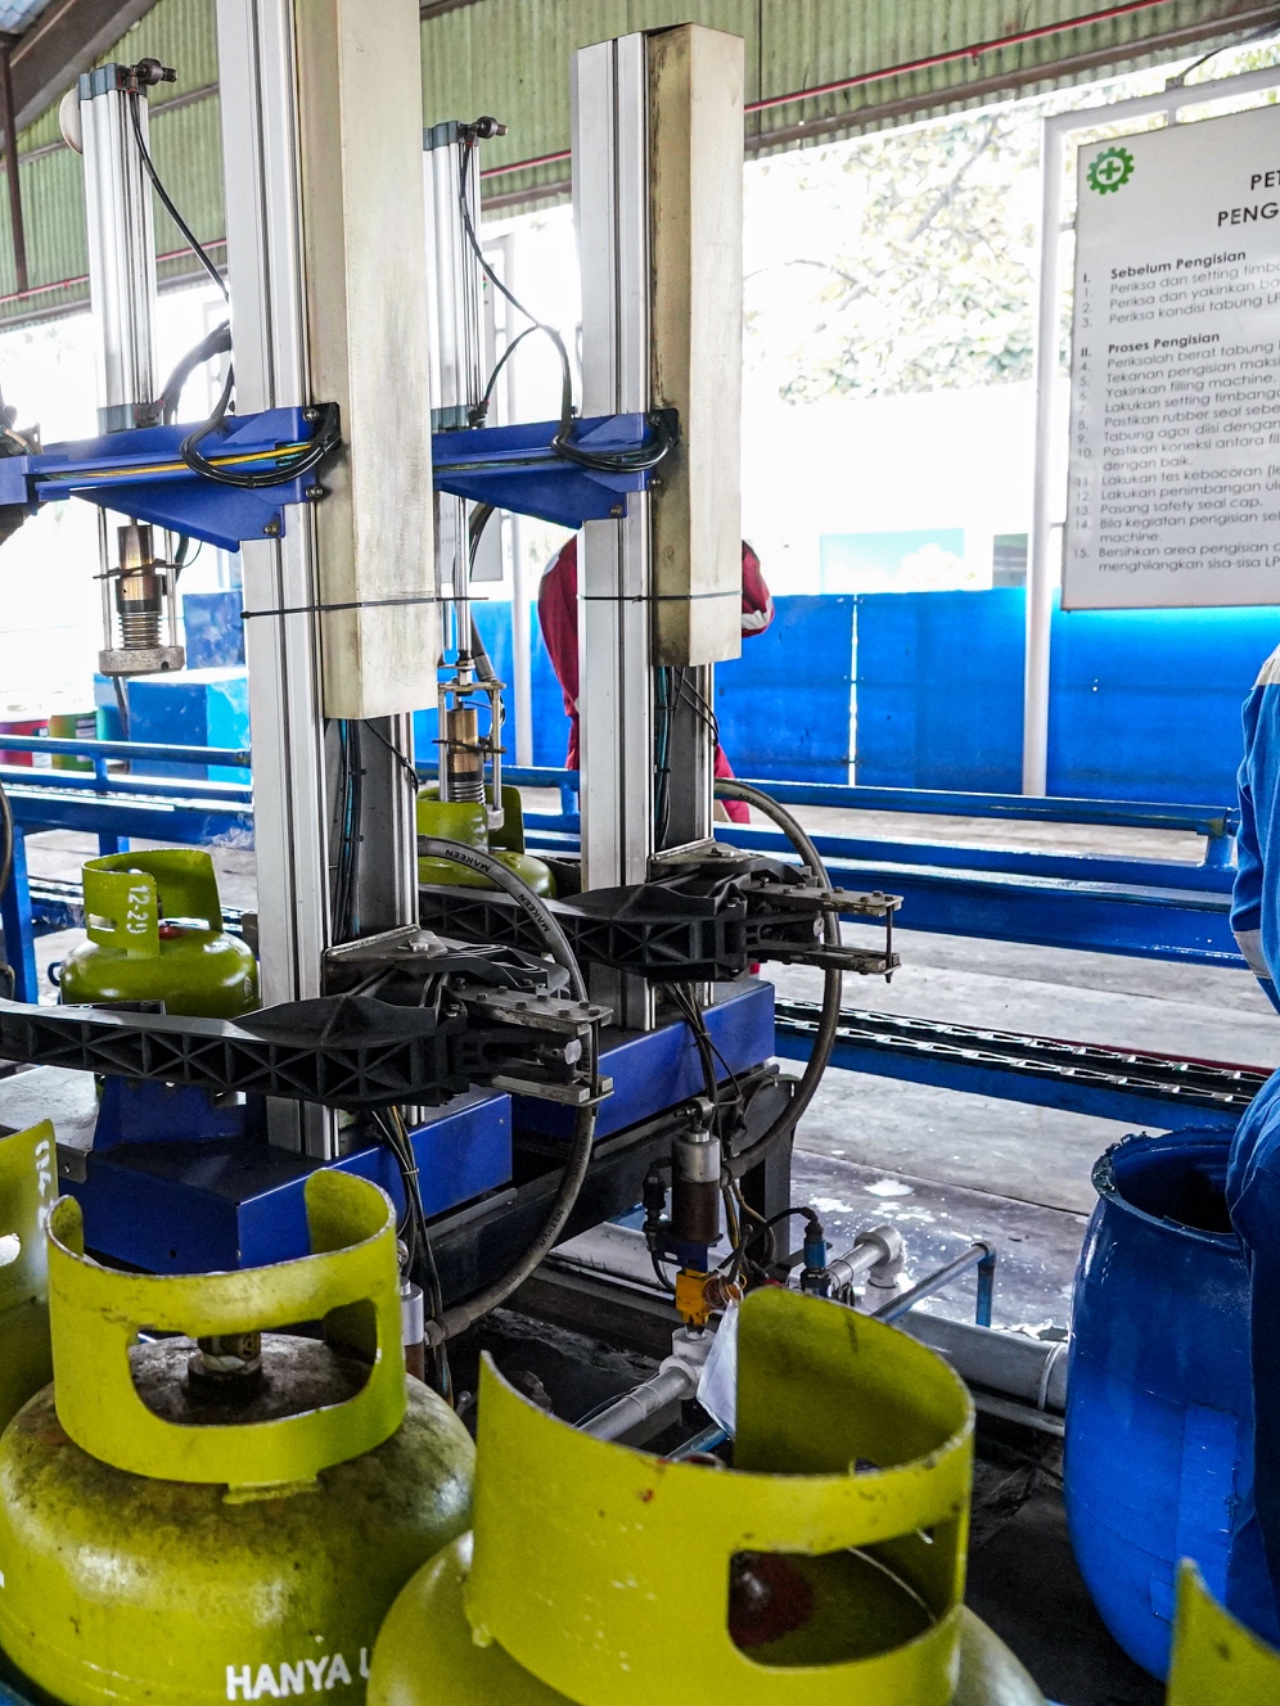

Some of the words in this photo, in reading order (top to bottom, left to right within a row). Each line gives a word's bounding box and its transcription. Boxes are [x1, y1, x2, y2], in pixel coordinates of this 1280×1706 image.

[1111, 262, 1172, 280] Sebelum
[1176, 251, 1246, 270] Pengisian
[1110, 281, 1156, 295] Periksa
[1160, 276, 1188, 288] dan
[1192, 266, 1239, 284] setting
[1109, 296, 1156, 310] Periksa
[1159, 290, 1187, 303] dan
[1191, 280, 1255, 300] yakinkan
[1109, 311, 1155, 325] Periksa
[1158, 304, 1206, 319] kondisi
[1209, 295, 1263, 312] tabung
[1108, 340, 1150, 355] Proses
[1153, 332, 1220, 350] Pengisian
[1177, 347, 1216, 362] berat
[1220, 341, 1275, 358] tabung
[1106, 370, 1164, 385] Tekanan
[1167, 362, 1236, 382] pengisian
[1106, 384, 1167, 399] Yakinkan
[1170, 378, 1205, 394] filling
[1208, 372, 1277, 388] machine.
[1105, 398, 1161, 414] Lakukan
[1164, 394, 1211, 411] setting
[1104, 413, 1160, 428] Pastikan
[1162, 407, 1209, 423] rubber
[1213, 405, 1242, 419] seal
[1104, 428, 1155, 444] Tabung
[1194, 421, 1220, 435] diisi
[1103, 441, 1158, 457] Pastikan
[1161, 436, 1212, 452] koneksi
[1215, 434, 1265, 449] antara
[1102, 470, 1157, 486] Lakukan
[1161, 470, 1181, 483] tes
[1184, 465, 1263, 481] kebocoran
[1103, 458, 1157, 473] dengan
[1101, 486, 1156, 501] Lakukan
[1160, 480, 1262, 499] penimbangan
[1100, 500, 1150, 516] Pasang
[1153, 498, 1195, 514] safety
[1198, 497, 1227, 511] seal
[1125, 513, 1186, 530] kegiatan
[1189, 509, 1259, 527] pengisian
[1099, 544, 1160, 559] Bersihkan
[1163, 544, 1196, 556] area
[1200, 540, 1269, 556] pengisian
[1099, 558, 1204, 574] menghilangkan
[445, 848, 491, 873] MAKEEN
[517, 893, 551, 932] MAKEEN
[226, 1652, 352, 1701] HANYA
